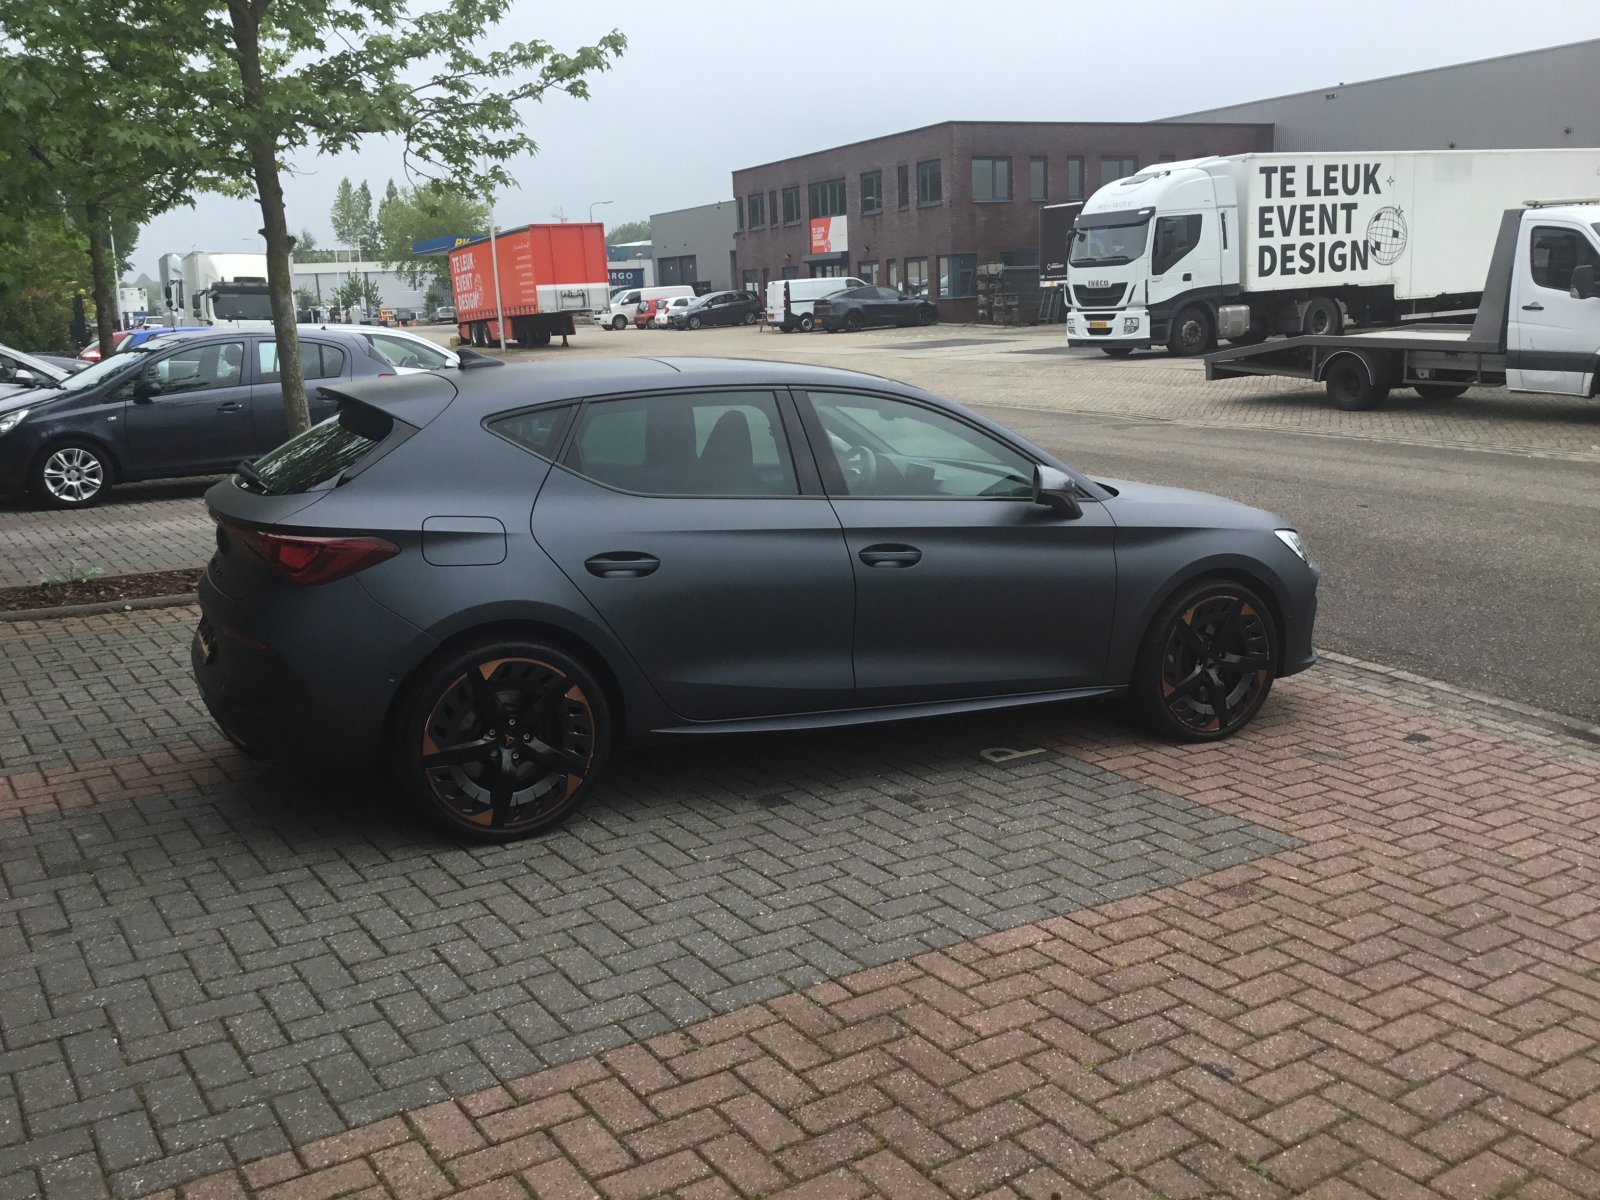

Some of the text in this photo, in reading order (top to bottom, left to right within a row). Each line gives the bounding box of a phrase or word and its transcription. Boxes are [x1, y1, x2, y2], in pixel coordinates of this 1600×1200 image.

[1259, 163, 1382, 199] TE LEUK
[1258, 202, 1358, 239] EVENT
[452, 252, 475, 274] TE LEUK
[1258, 239, 1369, 278] DESIGN
[455, 272, 473, 293] EVENT
[458, 291, 479, 311] DESIGN
